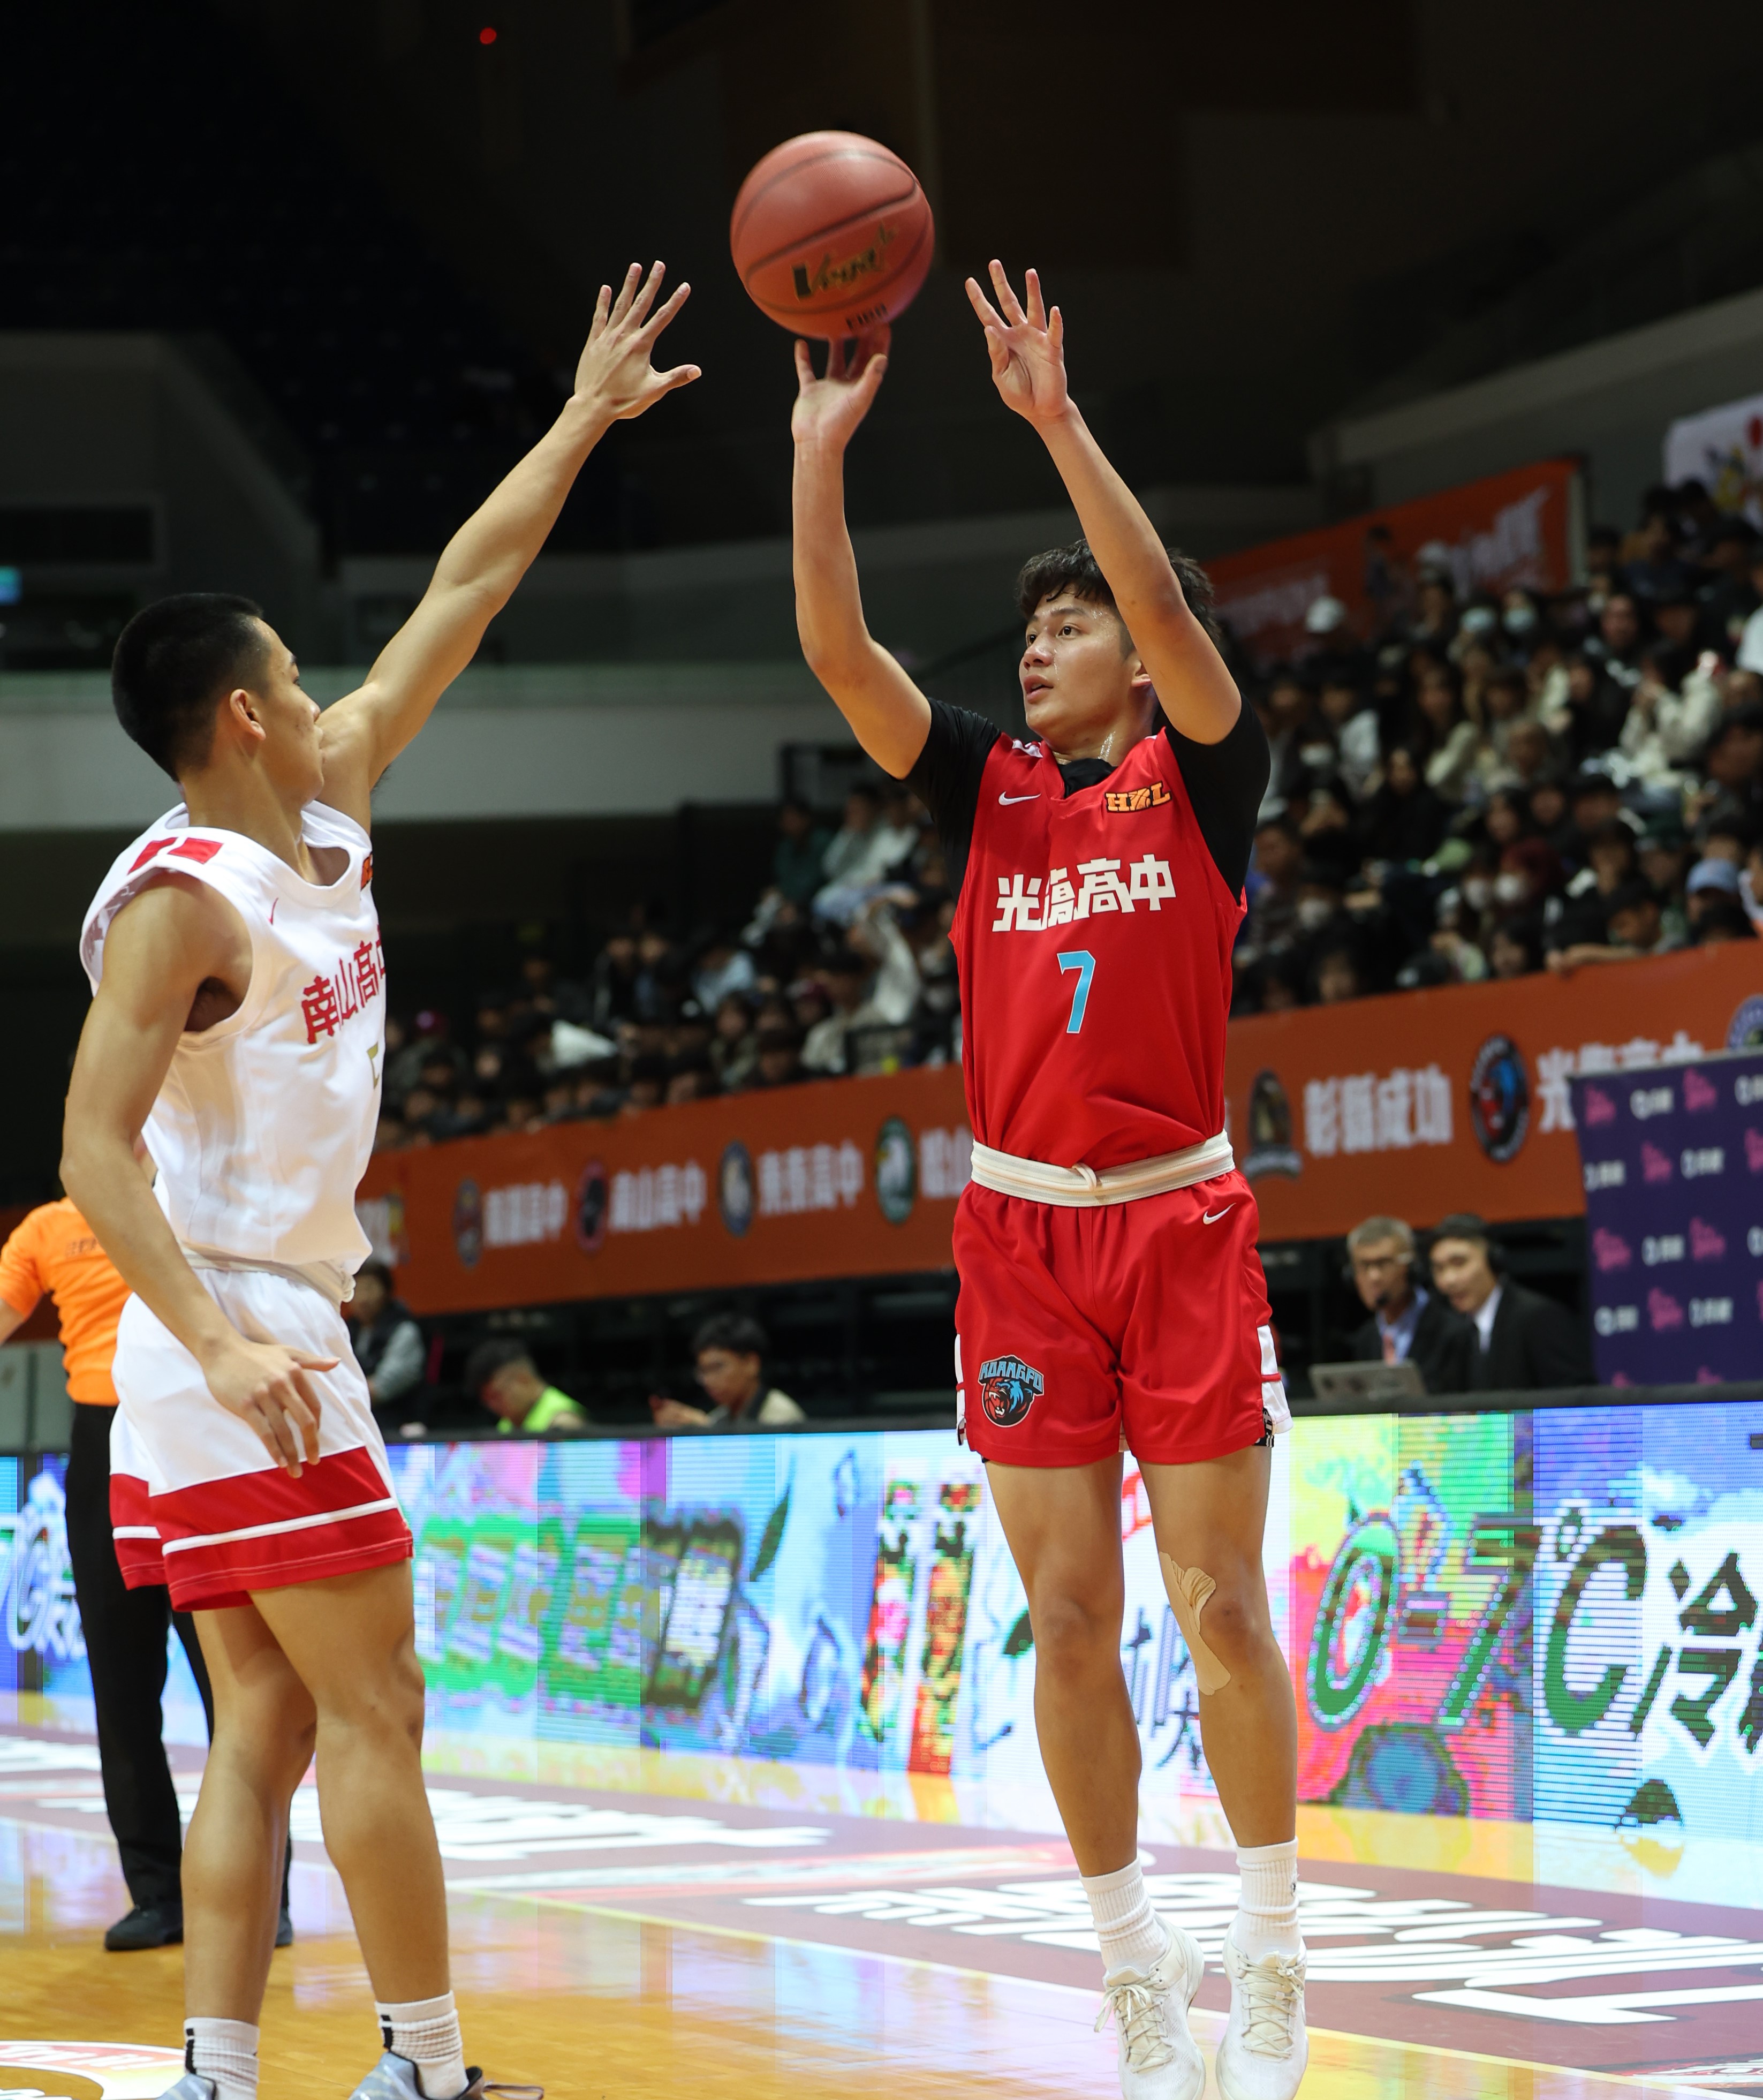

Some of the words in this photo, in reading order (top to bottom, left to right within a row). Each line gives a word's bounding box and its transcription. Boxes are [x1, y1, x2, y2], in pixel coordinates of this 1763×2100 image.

[992, 854, 1176, 932] 光復高中
[1057, 950, 1096, 1033] 7
